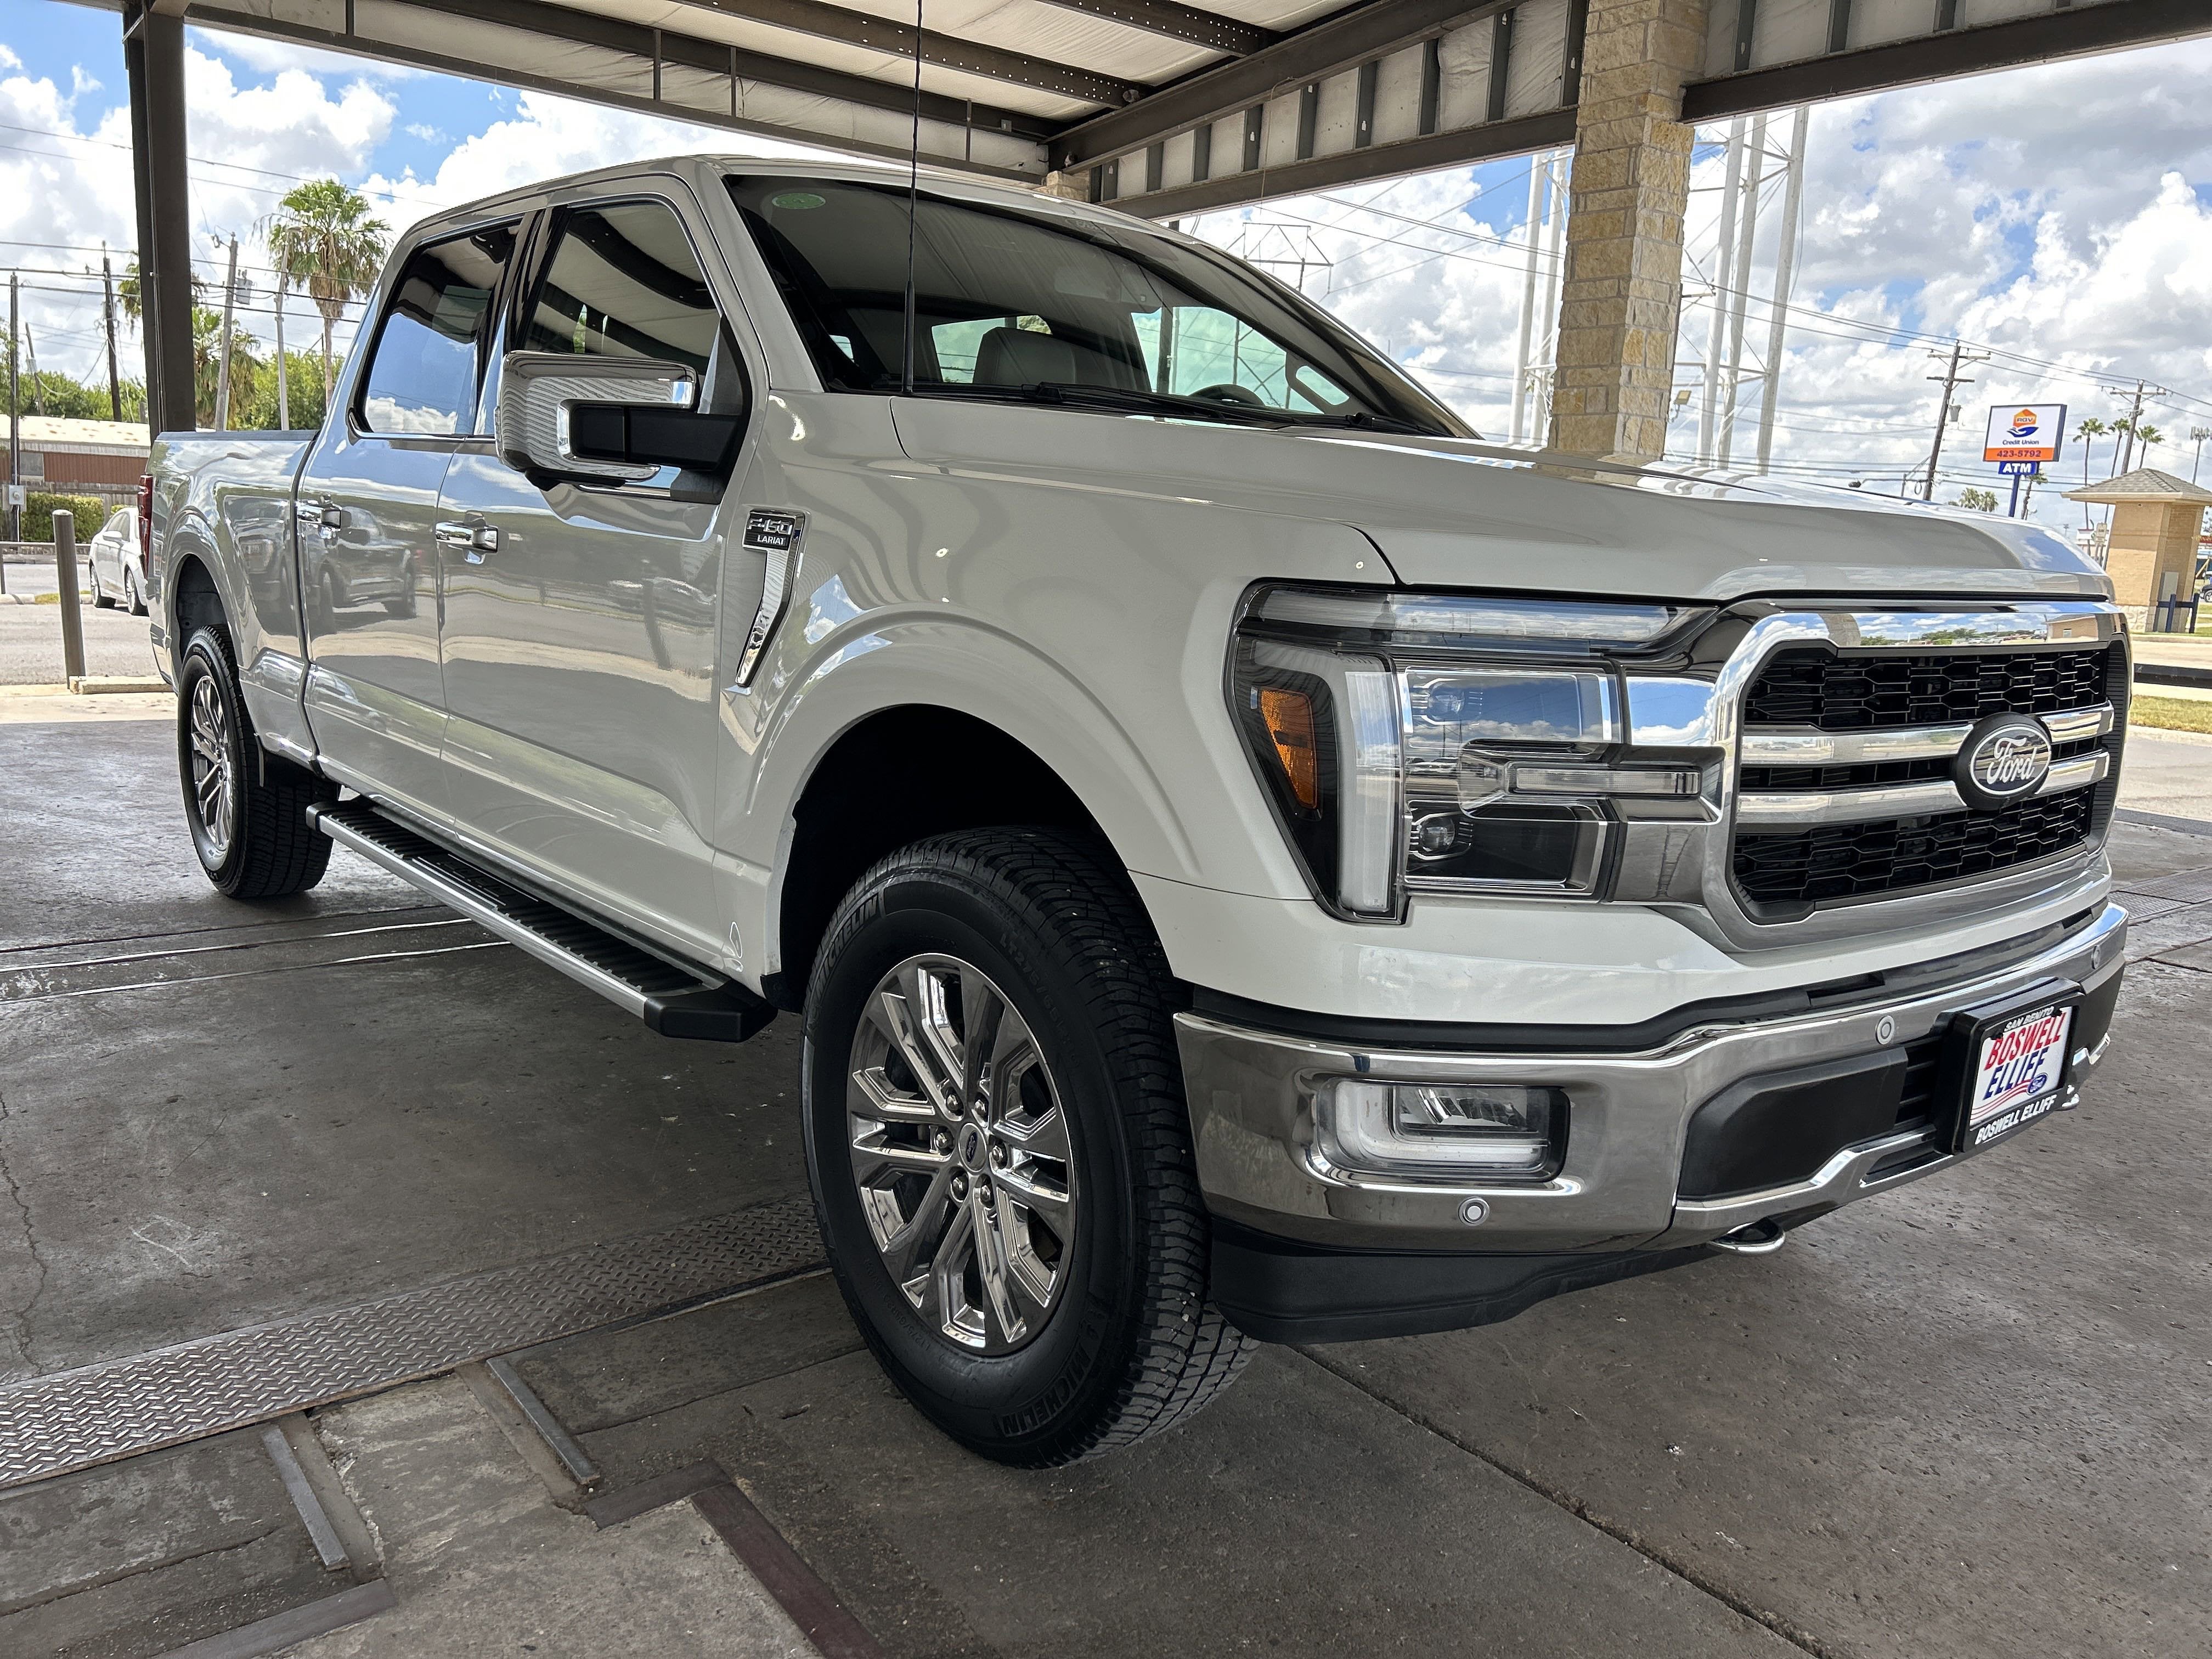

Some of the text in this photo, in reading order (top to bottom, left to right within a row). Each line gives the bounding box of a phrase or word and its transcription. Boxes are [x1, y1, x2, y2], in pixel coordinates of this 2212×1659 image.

[2002, 462, 2032, 473] ATM
[747, 518, 793, 535] F-150
[757, 534, 786, 545] LARIAT
[1987, 737, 2038, 785] Ford
[815, 893, 878, 1001] MICHELIN
[1983, 1011, 2066, 1071] BOSWELL
[2004, 1017, 2024, 1032] SAN
[1982, 1046, 2050, 1101] ELLIFF
[1975, 1094, 2057, 1145] BOSWELL ELLIFF
[999, 1343, 1093, 1436] MICHELIN
